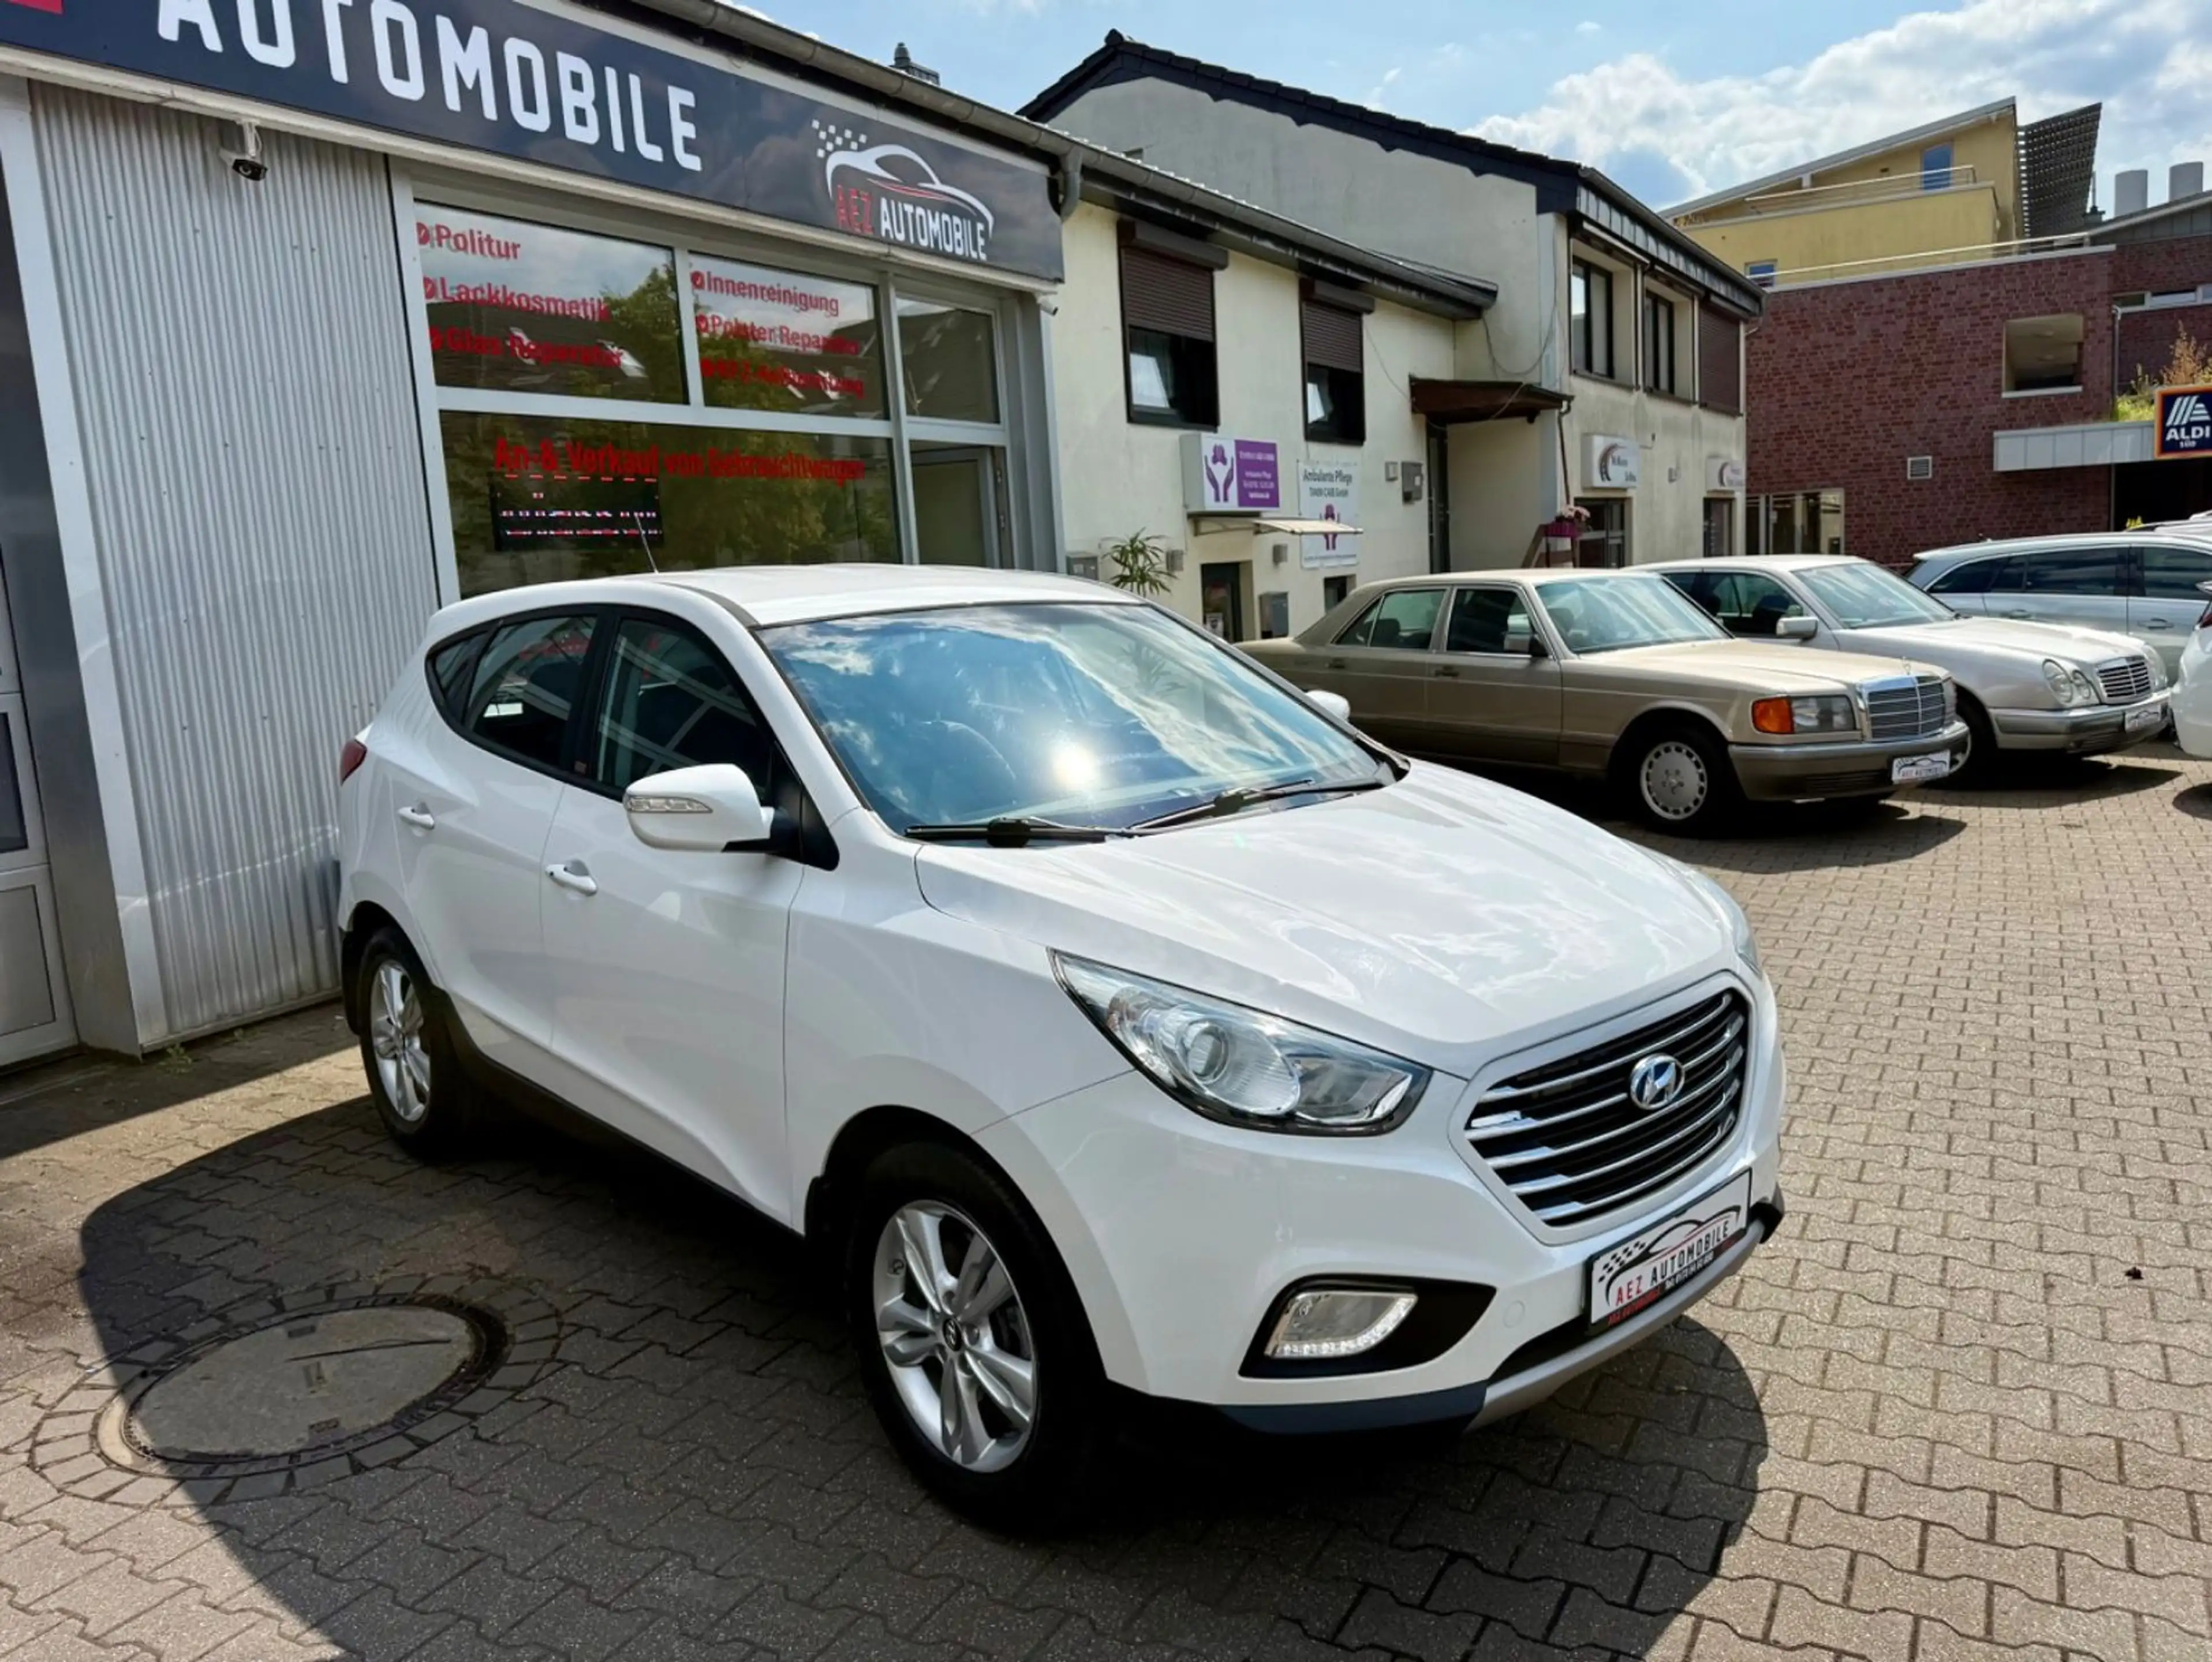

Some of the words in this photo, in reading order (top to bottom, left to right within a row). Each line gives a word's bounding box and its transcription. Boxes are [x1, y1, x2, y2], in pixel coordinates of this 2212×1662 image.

[435, 224, 521, 259] Politur
[836, 184, 874, 235] AEZ
[880, 197, 987, 261] AUTOMOBILE
[441, 277, 612, 321] Lackkosmetik
[707, 271, 839, 317] Innenreinigung
[2165, 425, 2211, 441] ALDI
[565, 441, 659, 476] Verkauf
[1616, 1275, 1643, 1306] AEZ
[1650, 1220, 1729, 1286] AUTOMOBILE
